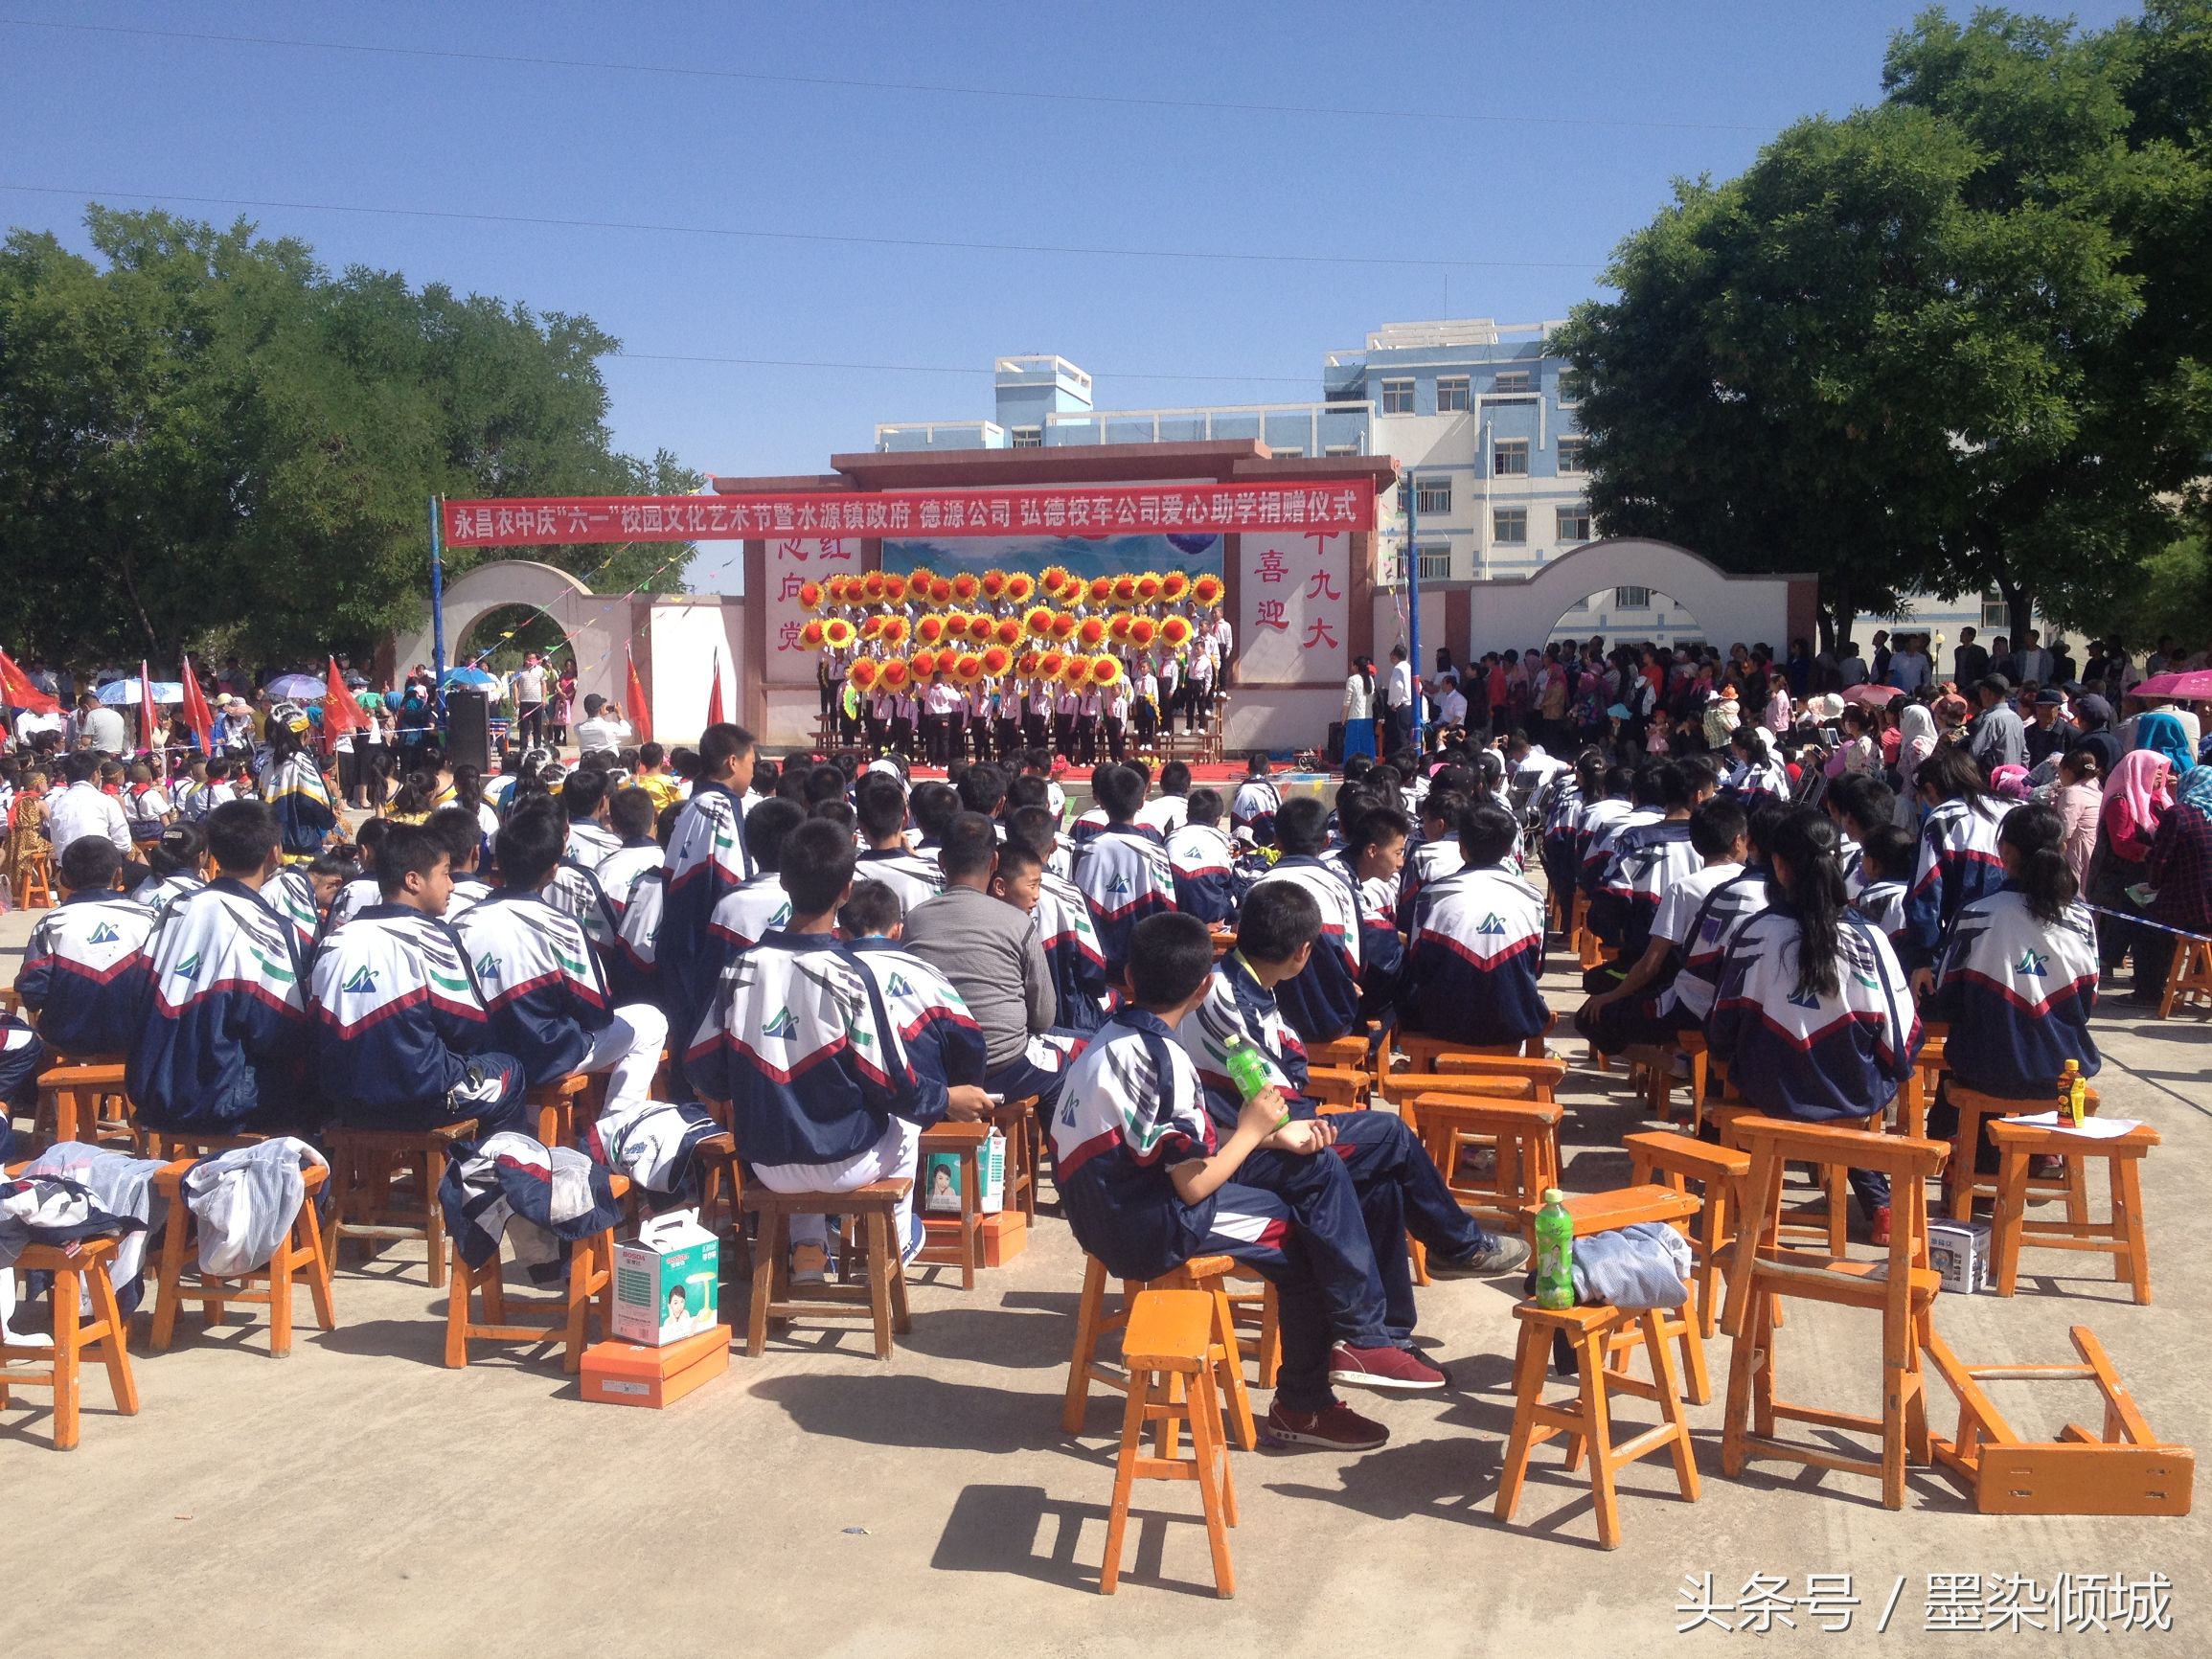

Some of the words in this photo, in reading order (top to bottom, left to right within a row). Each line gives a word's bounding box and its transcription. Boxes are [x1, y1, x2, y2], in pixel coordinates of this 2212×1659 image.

[920, 498, 1009, 528] 德源公司
[1020, 489, 1357, 527] 弘德校车公司爱心助学捐赠仪式
[1253, 549, 1290, 630] 喜迎
